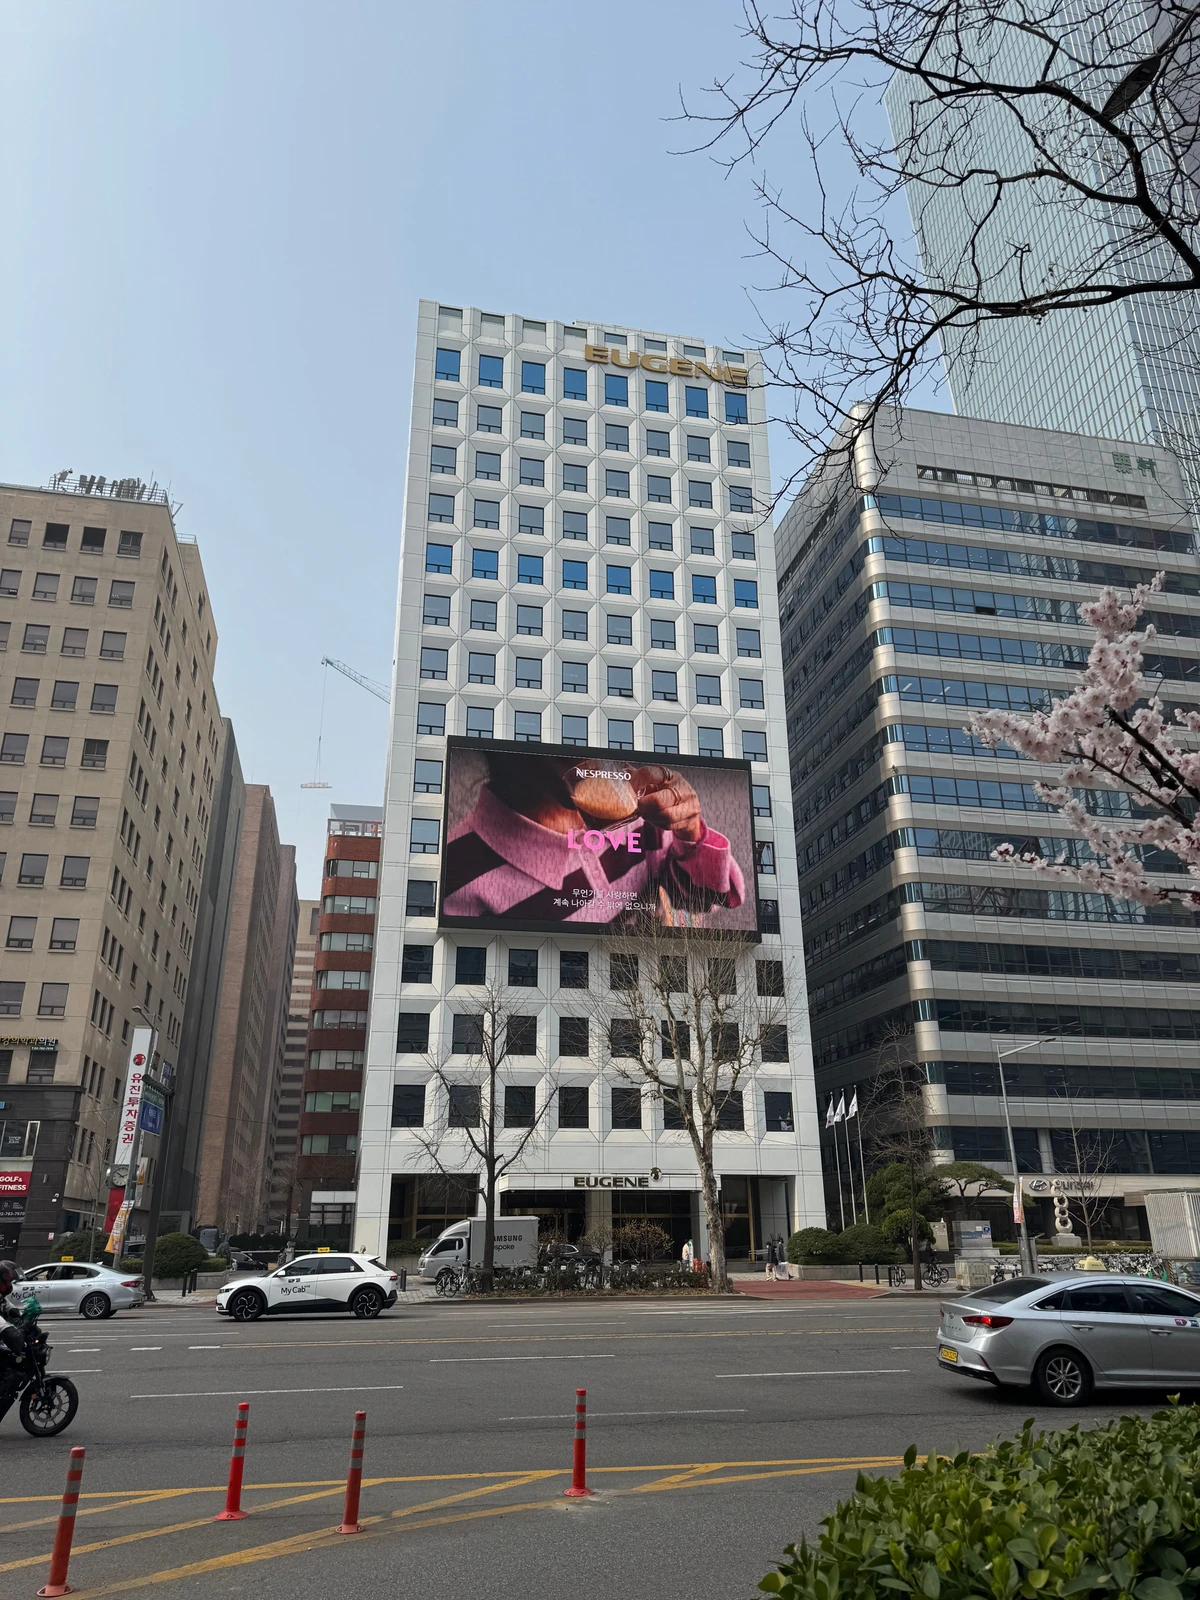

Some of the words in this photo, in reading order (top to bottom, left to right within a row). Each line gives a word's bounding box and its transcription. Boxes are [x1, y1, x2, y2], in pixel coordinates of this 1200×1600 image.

[585, 344, 748, 385] EUGENE
[576, 767, 632, 781] NESPRESSO
[567, 828, 642, 853] LOVE
[572, 888, 604, 899] 무언가를
[606, 890, 638, 900] 사랑하면
[553, 898, 569, 907] 계속
[571, 899, 595, 908] 나아갈
[598, 901, 605, 909] 수
[0, 1036, 56, 1046] 강의학과의원
[122, 1073, 142, 1143] 유진투자증권
[573, 1176, 649, 1188] EUGENE
[493, 1244, 515, 1252] spoke
